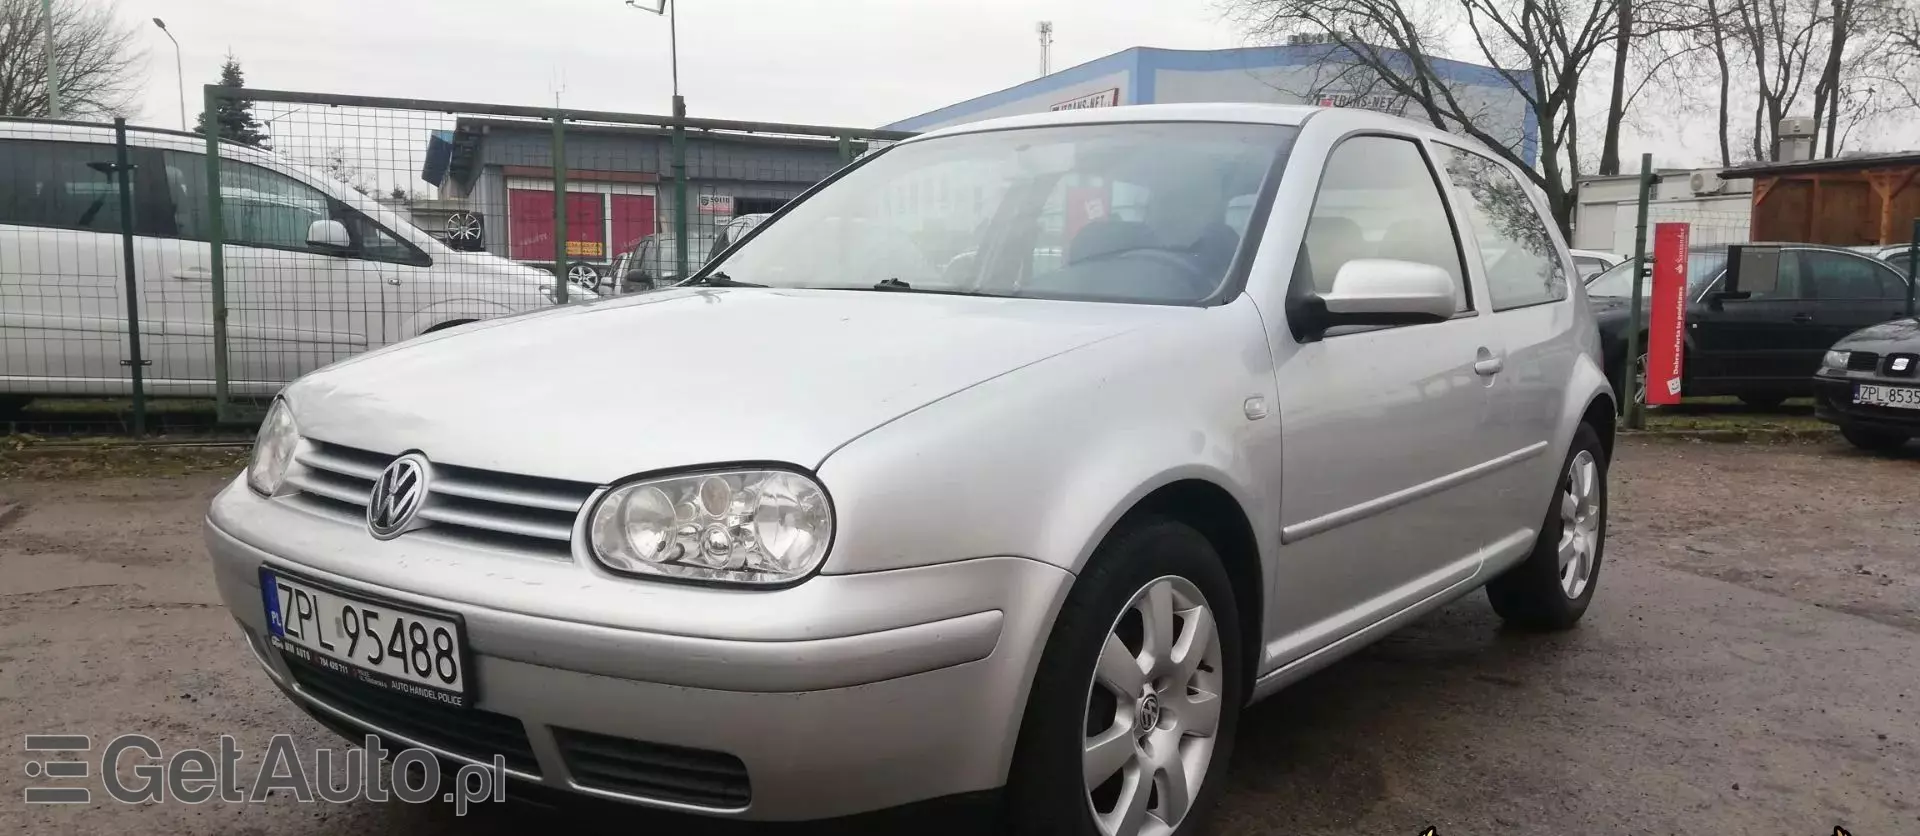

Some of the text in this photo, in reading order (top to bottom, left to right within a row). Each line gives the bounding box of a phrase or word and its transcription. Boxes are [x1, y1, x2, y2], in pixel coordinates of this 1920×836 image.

[1861, 386, 1884, 401] ZPL
[271, 610, 282, 627] PL
[278, 583, 457, 684] ZPL 95488
[391, 681, 409, 693] AUTO
[409, 685, 437, 701] HANDEL
[437, 692, 462, 706] POLICE
